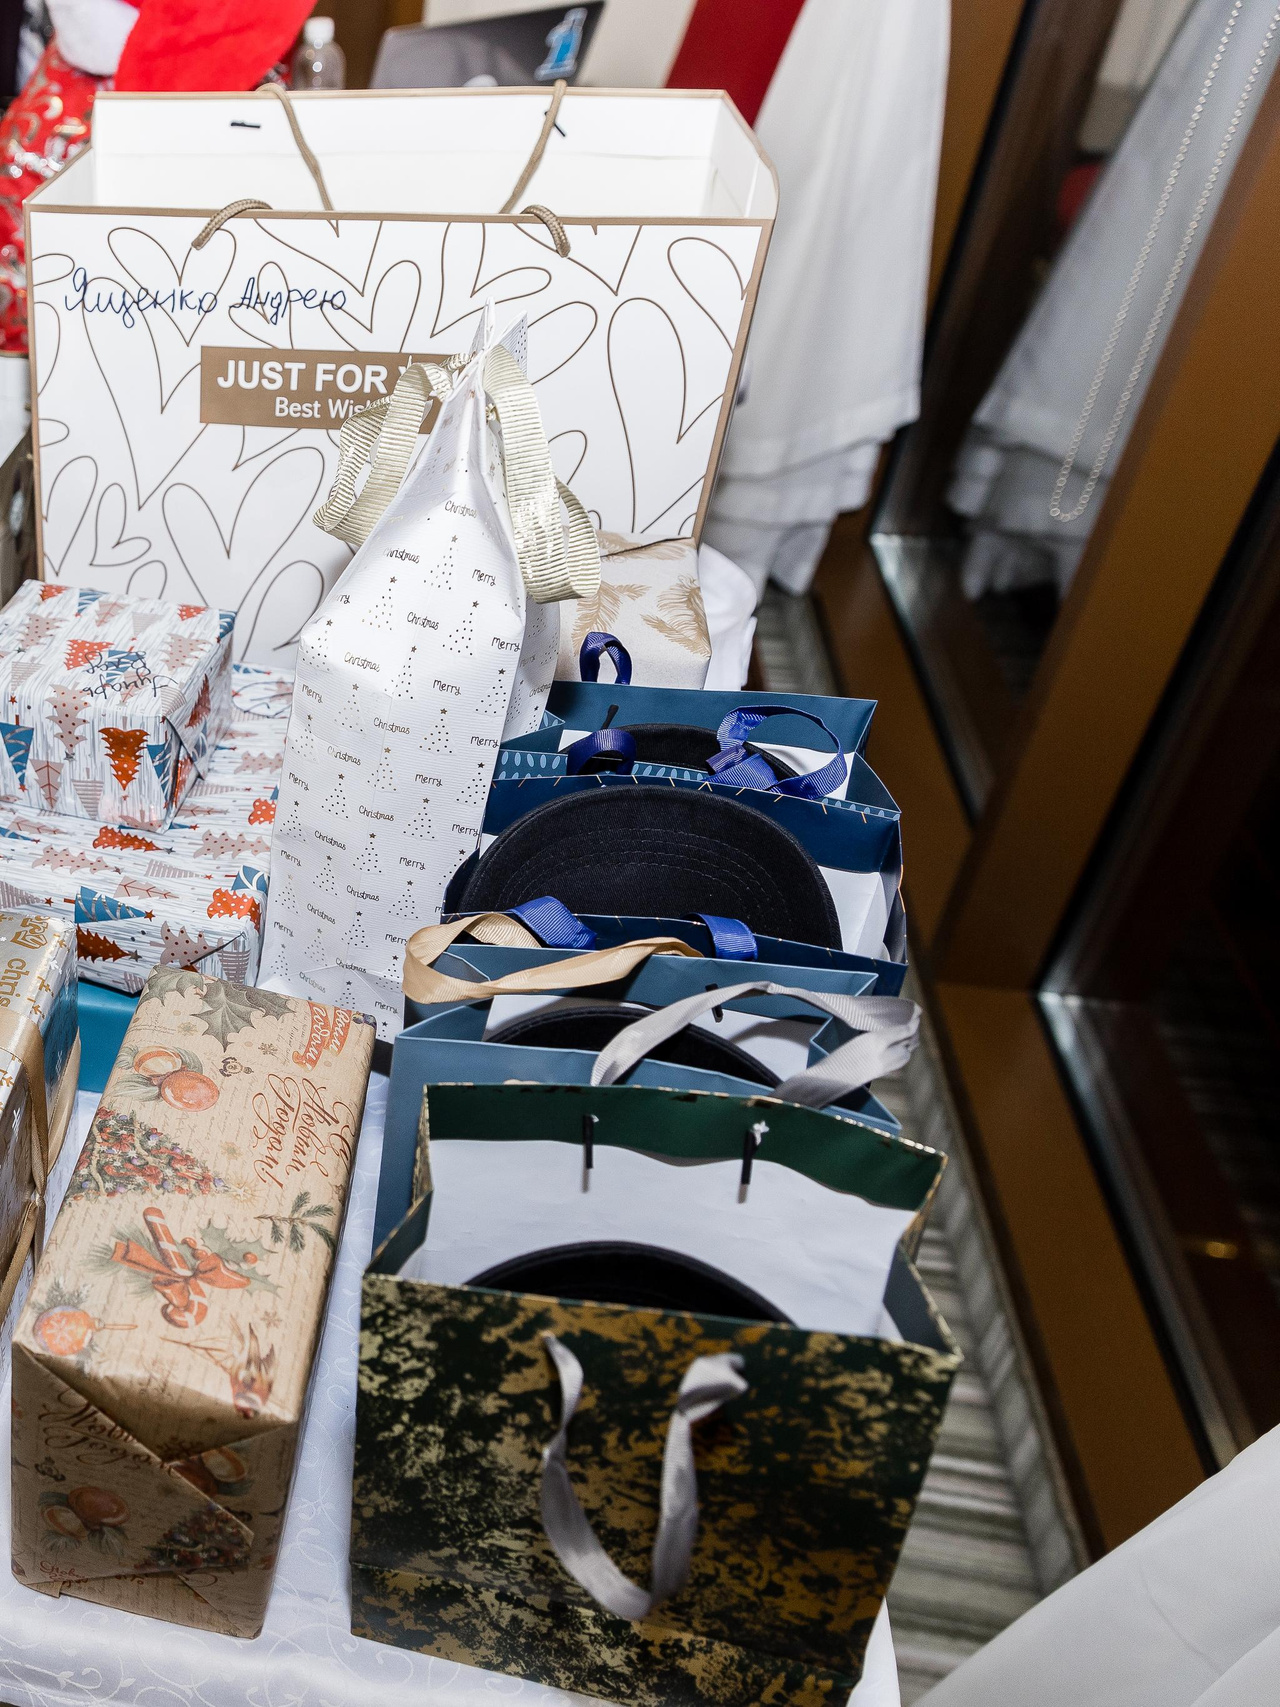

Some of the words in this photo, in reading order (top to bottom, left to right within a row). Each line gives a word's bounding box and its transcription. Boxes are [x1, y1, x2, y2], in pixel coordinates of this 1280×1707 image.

[65, 267, 217, 328] Ященко
[230, 277, 346, 326] Андрею
[217, 360, 306, 391] JUST
[315, 363, 388, 394] FOR
[275, 397, 321, 419] Best
[407, 611, 439, 630] Christmas
[373, 717, 410, 735] Christmas
[358, 805, 394, 822] Christmas
[314, 830, 347, 850] Christmas
[346, 884, 380, 902] Christmas
